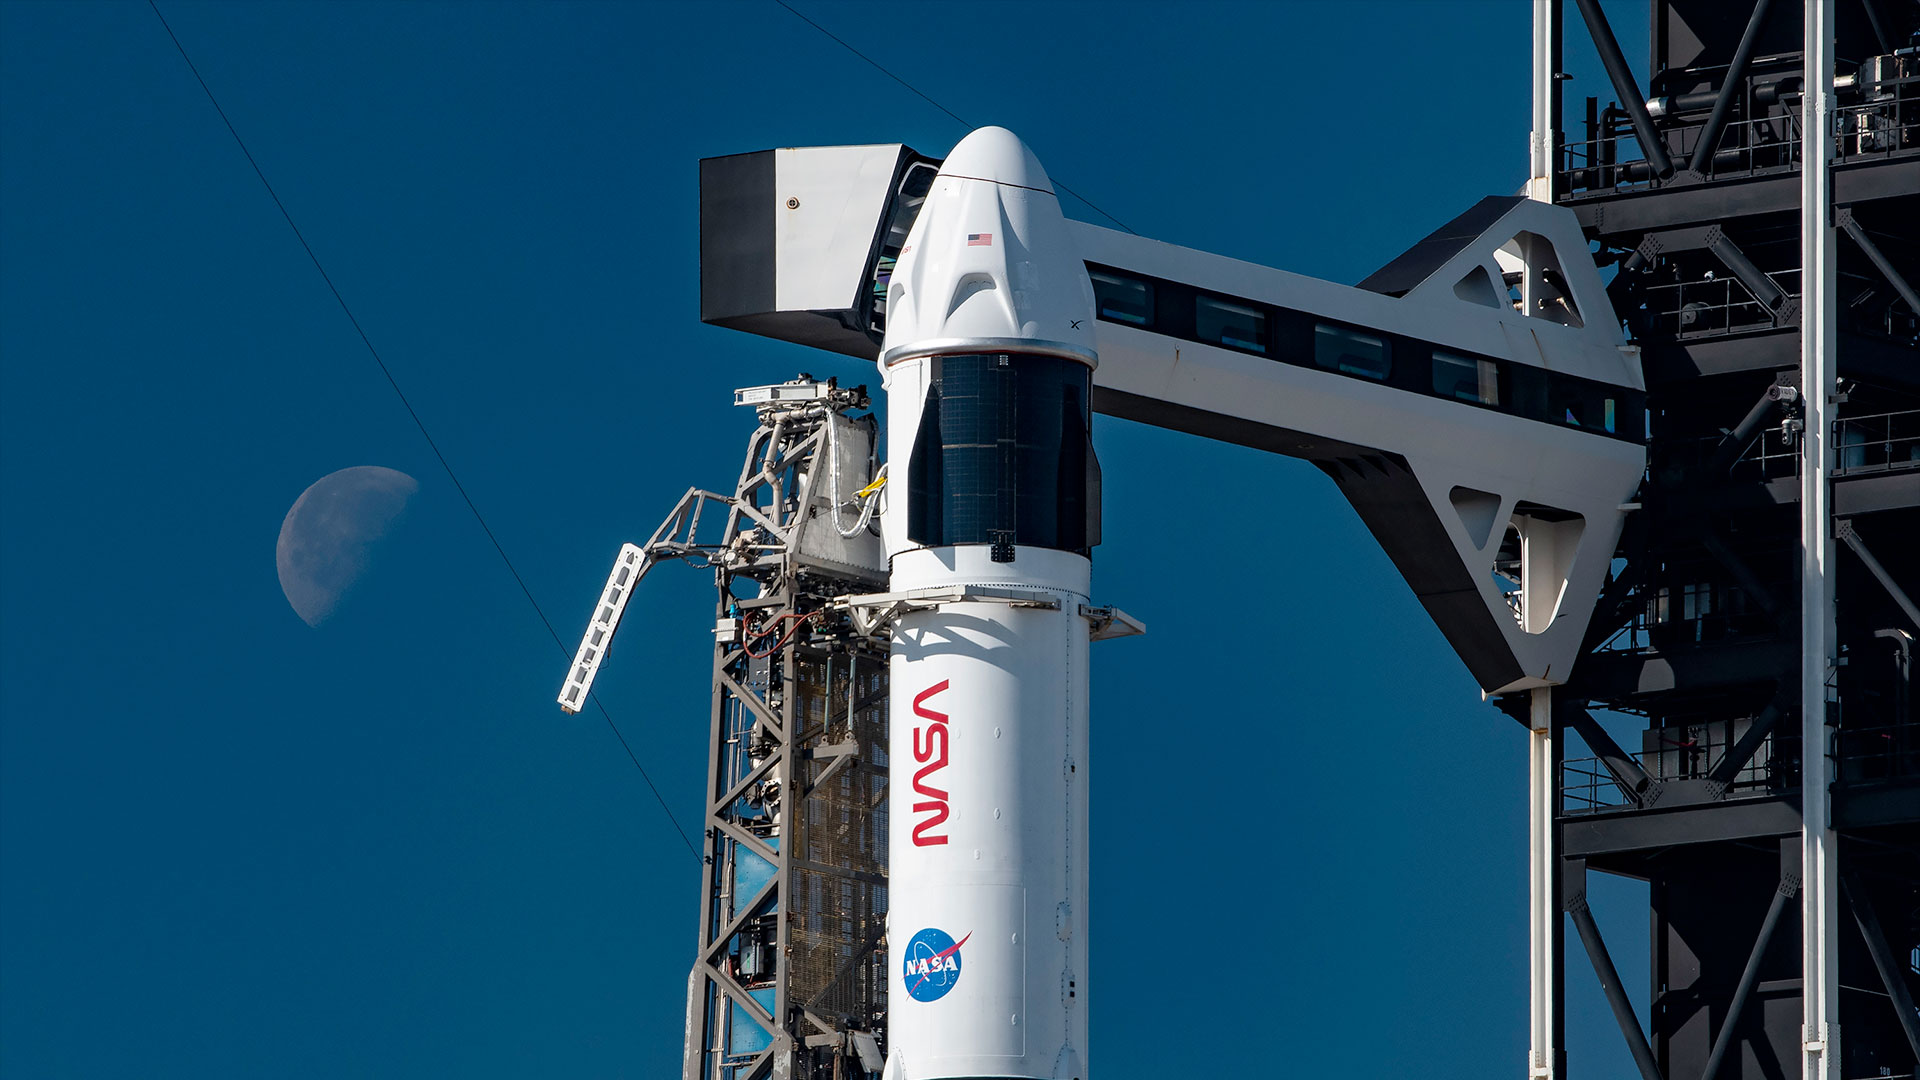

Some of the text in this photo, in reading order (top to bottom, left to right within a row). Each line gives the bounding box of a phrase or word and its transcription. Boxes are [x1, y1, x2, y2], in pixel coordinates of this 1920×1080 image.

[912, 679, 950, 848] NASA
[906, 955, 959, 977] NASA
[1880, 1065, 1891, 1076] 180
